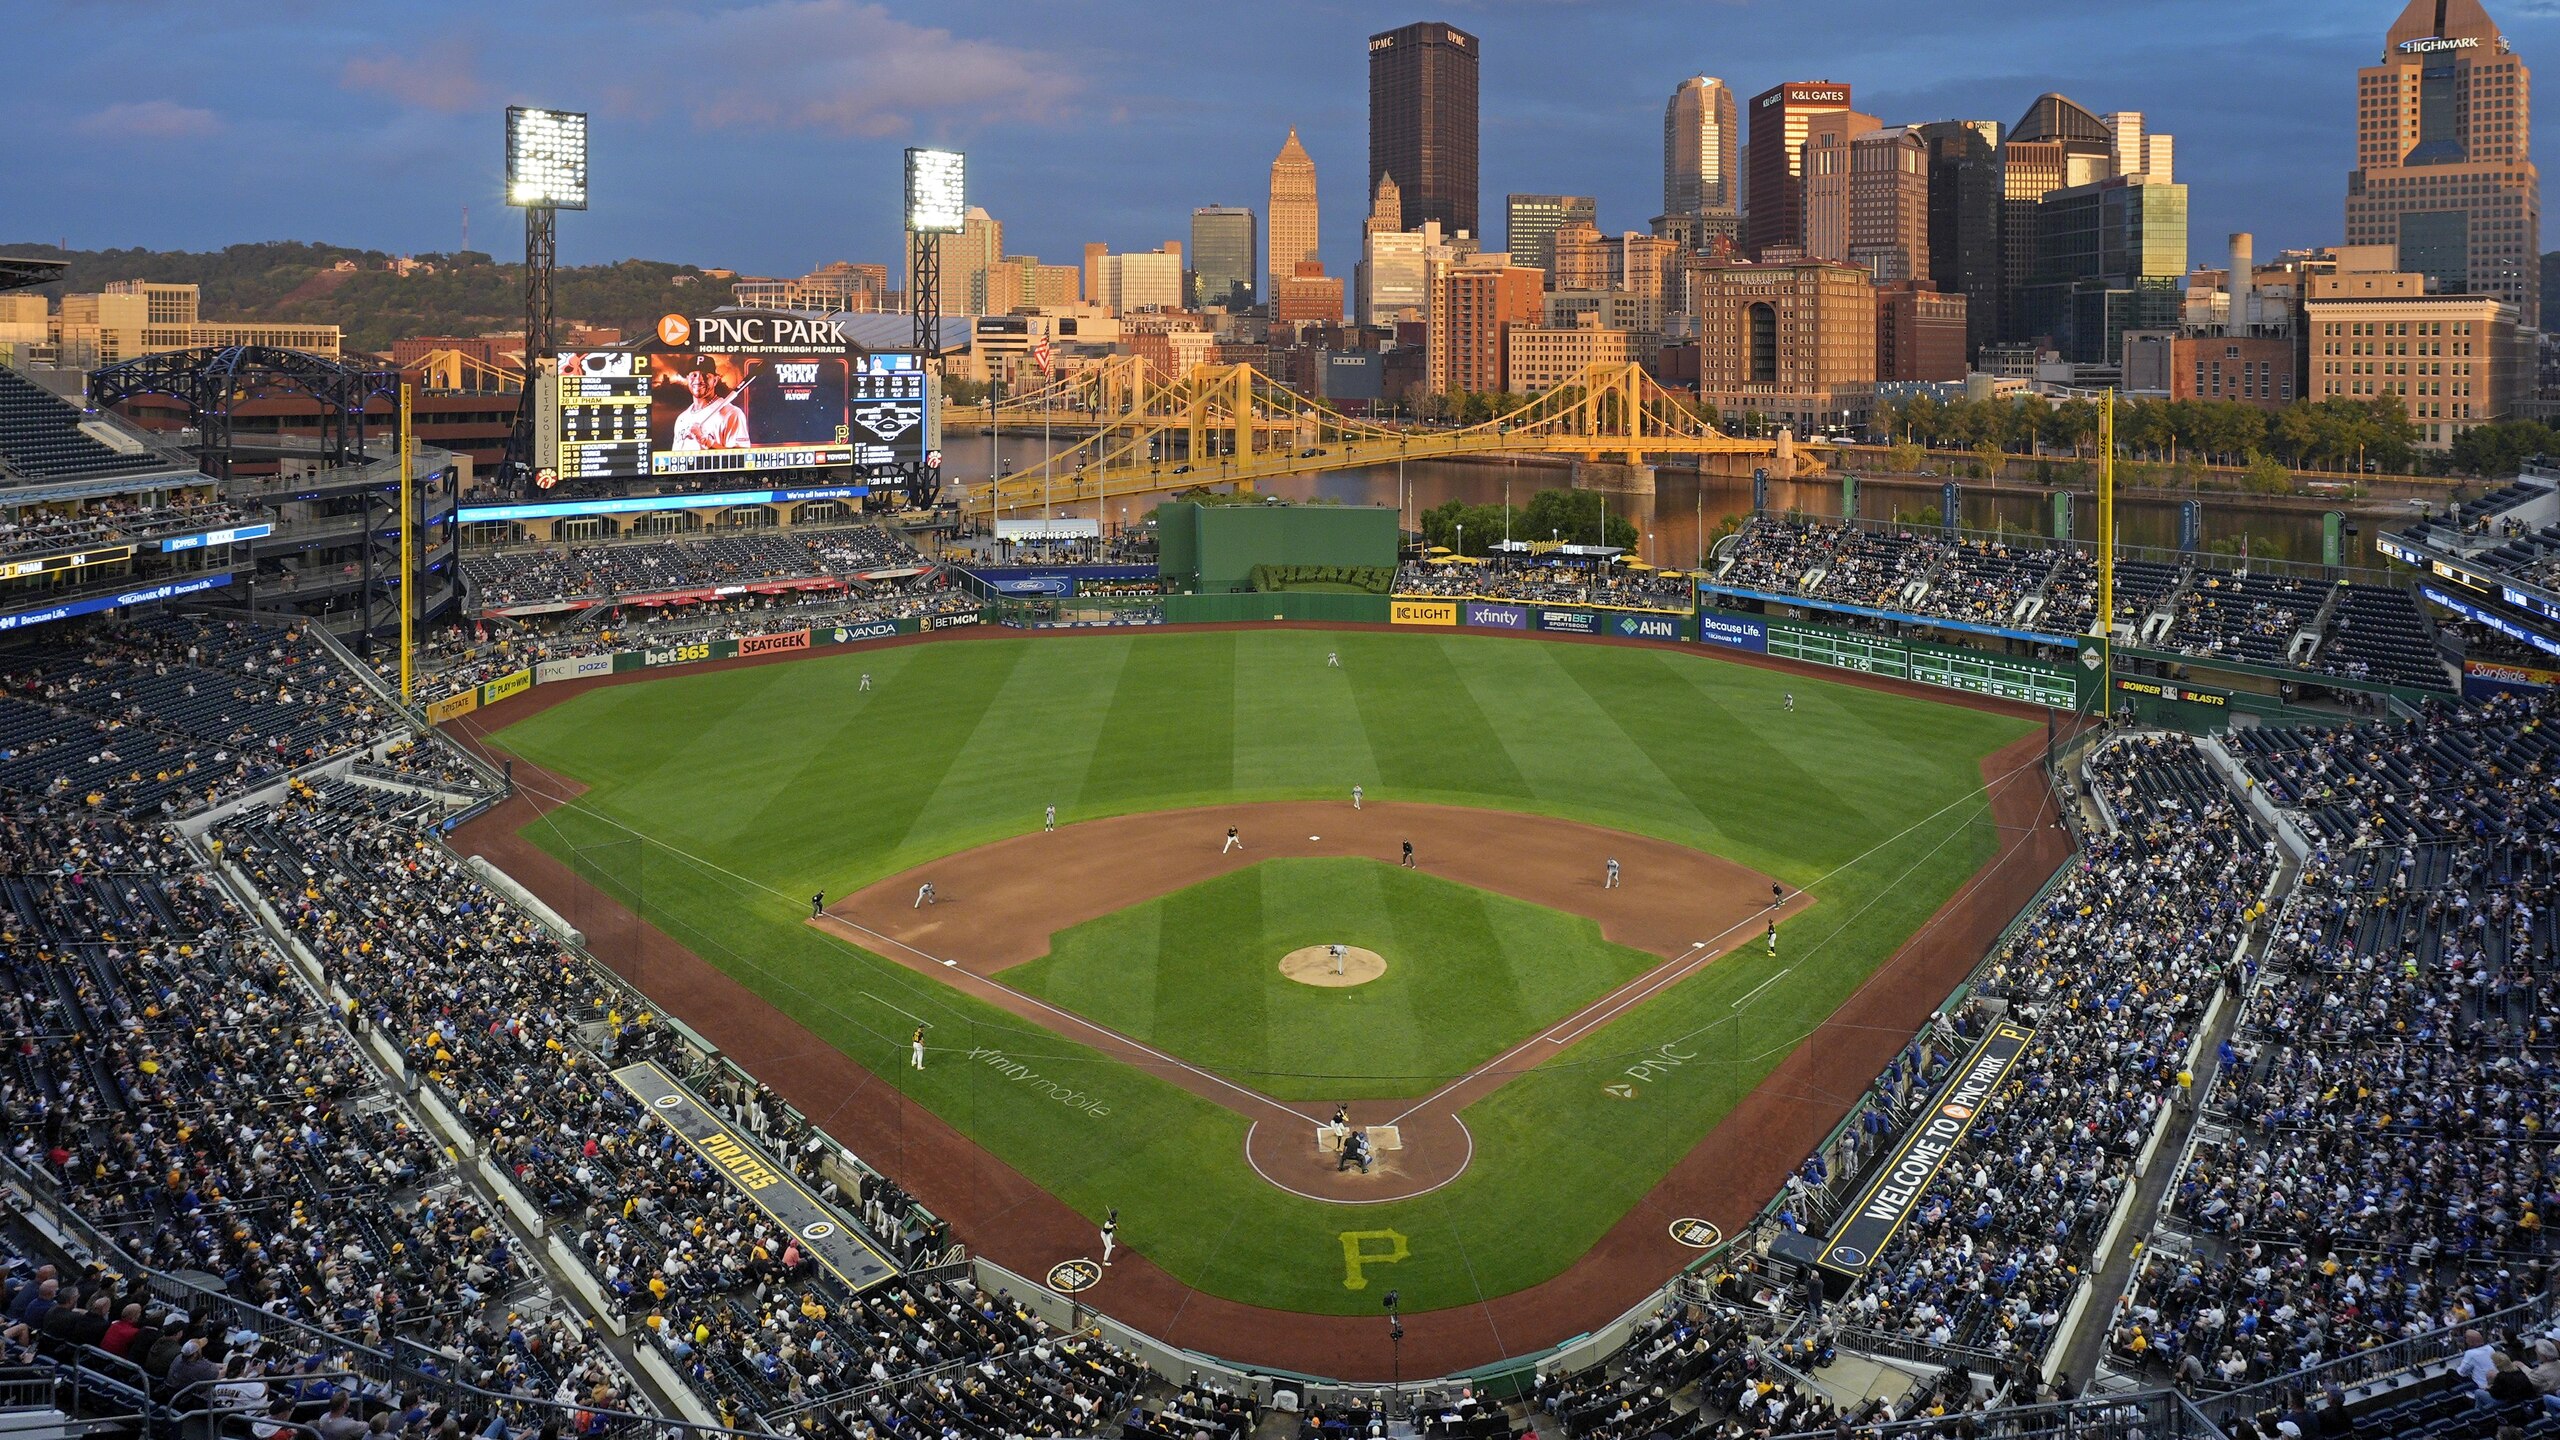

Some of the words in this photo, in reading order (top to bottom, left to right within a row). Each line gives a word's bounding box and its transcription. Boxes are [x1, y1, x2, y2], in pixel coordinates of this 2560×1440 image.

[1369, 36, 1394, 52] UPMC
[1447, 30, 1466, 47] UPMC
[2407, 37, 2479, 53] HIGHMARK
[1770, 92, 1782, 105] GATES
[1792, 90, 1810, 100] K&L
[1812, 91, 1844, 101] GATES
[696, 318, 764, 343] PNC
[771, 319, 847, 344] PARK
[699, 345, 726, 353] HOME
[727, 345, 740, 353] OF
[740, 345, 758, 353] THE
[760, 346, 812, 354] PITTSBURGH
[634, 356, 648, 374] P
[696, 356, 704, 366] P
[774, 364, 820, 374] TOMMY
[915, 356, 922, 370] 1
[779, 372, 816, 383] PHAM
[543, 382, 551, 412] LETZ
[543, 417, 550, 430] GO
[835, 424, 850, 444] P
[836, 489, 852, 498] play.
[1023, 532, 1042, 540] FAT
[1046, 531, 1089, 540] HEAD'S
[172, 538, 198, 550] KOPPERS
[1512, 542, 1528, 552] IT'S
[1528, 539, 1570, 556] Miller
[1562, 544, 1584, 555] TIME
[18, 562, 42, 574] PHAM
[1262, 564, 1395, 594] PIRATES
[121, 590, 158, 605] HIGHMARK
[174, 583, 199, 594] Because
[21, 612, 52, 625] Because
[935, 614, 978, 628] BETMGM
[1397, 608, 1410, 620] IC
[1414, 608, 1450, 620] LIGHT
[1474, 608, 1518, 626] xfinity
[848, 624, 896, 638] VANDA
[1640, 621, 1672, 636] AHN
[1705, 618, 1742, 634] Because
[1743, 624, 1761, 638] Life.
[1847, 631, 1870, 640] WELCOME
[742, 633, 806, 654] SEATGEEK
[1784, 625, 1838, 639] NATIONAL
[1846, 636, 1889, 648] LEAGUE
[645, 644, 710, 666] bet365
[1930, 650, 1994, 666] AMERICAN
[2004, 662, 2056, 676] LEAGUE
[544, 666, 565, 676] PNC
[578, 660, 608, 674] paze
[2472, 664, 2527, 683] Surfside
[498, 680, 512, 694] PLAY
[516, 676, 529, 686] WIN!
[2122, 681, 2161, 695] BOWSER
[442, 698, 469, 714] TRISTATE
[2187, 692, 2224, 706] BLASTS
[2000, 1028, 2025, 1040] P
[1624, 1044, 1698, 1082] PNC
[1968, 1054, 2007, 1084] PARK
[966, 1046, 1039, 1081] xfinity
[1030, 1079, 1111, 1118] mobile
[1952, 1080, 1988, 1108] PNC
[1926, 1118, 1960, 1140] TO
[698, 1132, 780, 1190] PIRATES
[1864, 1137, 1942, 1221] WELCOME
[1339, 1228, 1412, 1290] P
